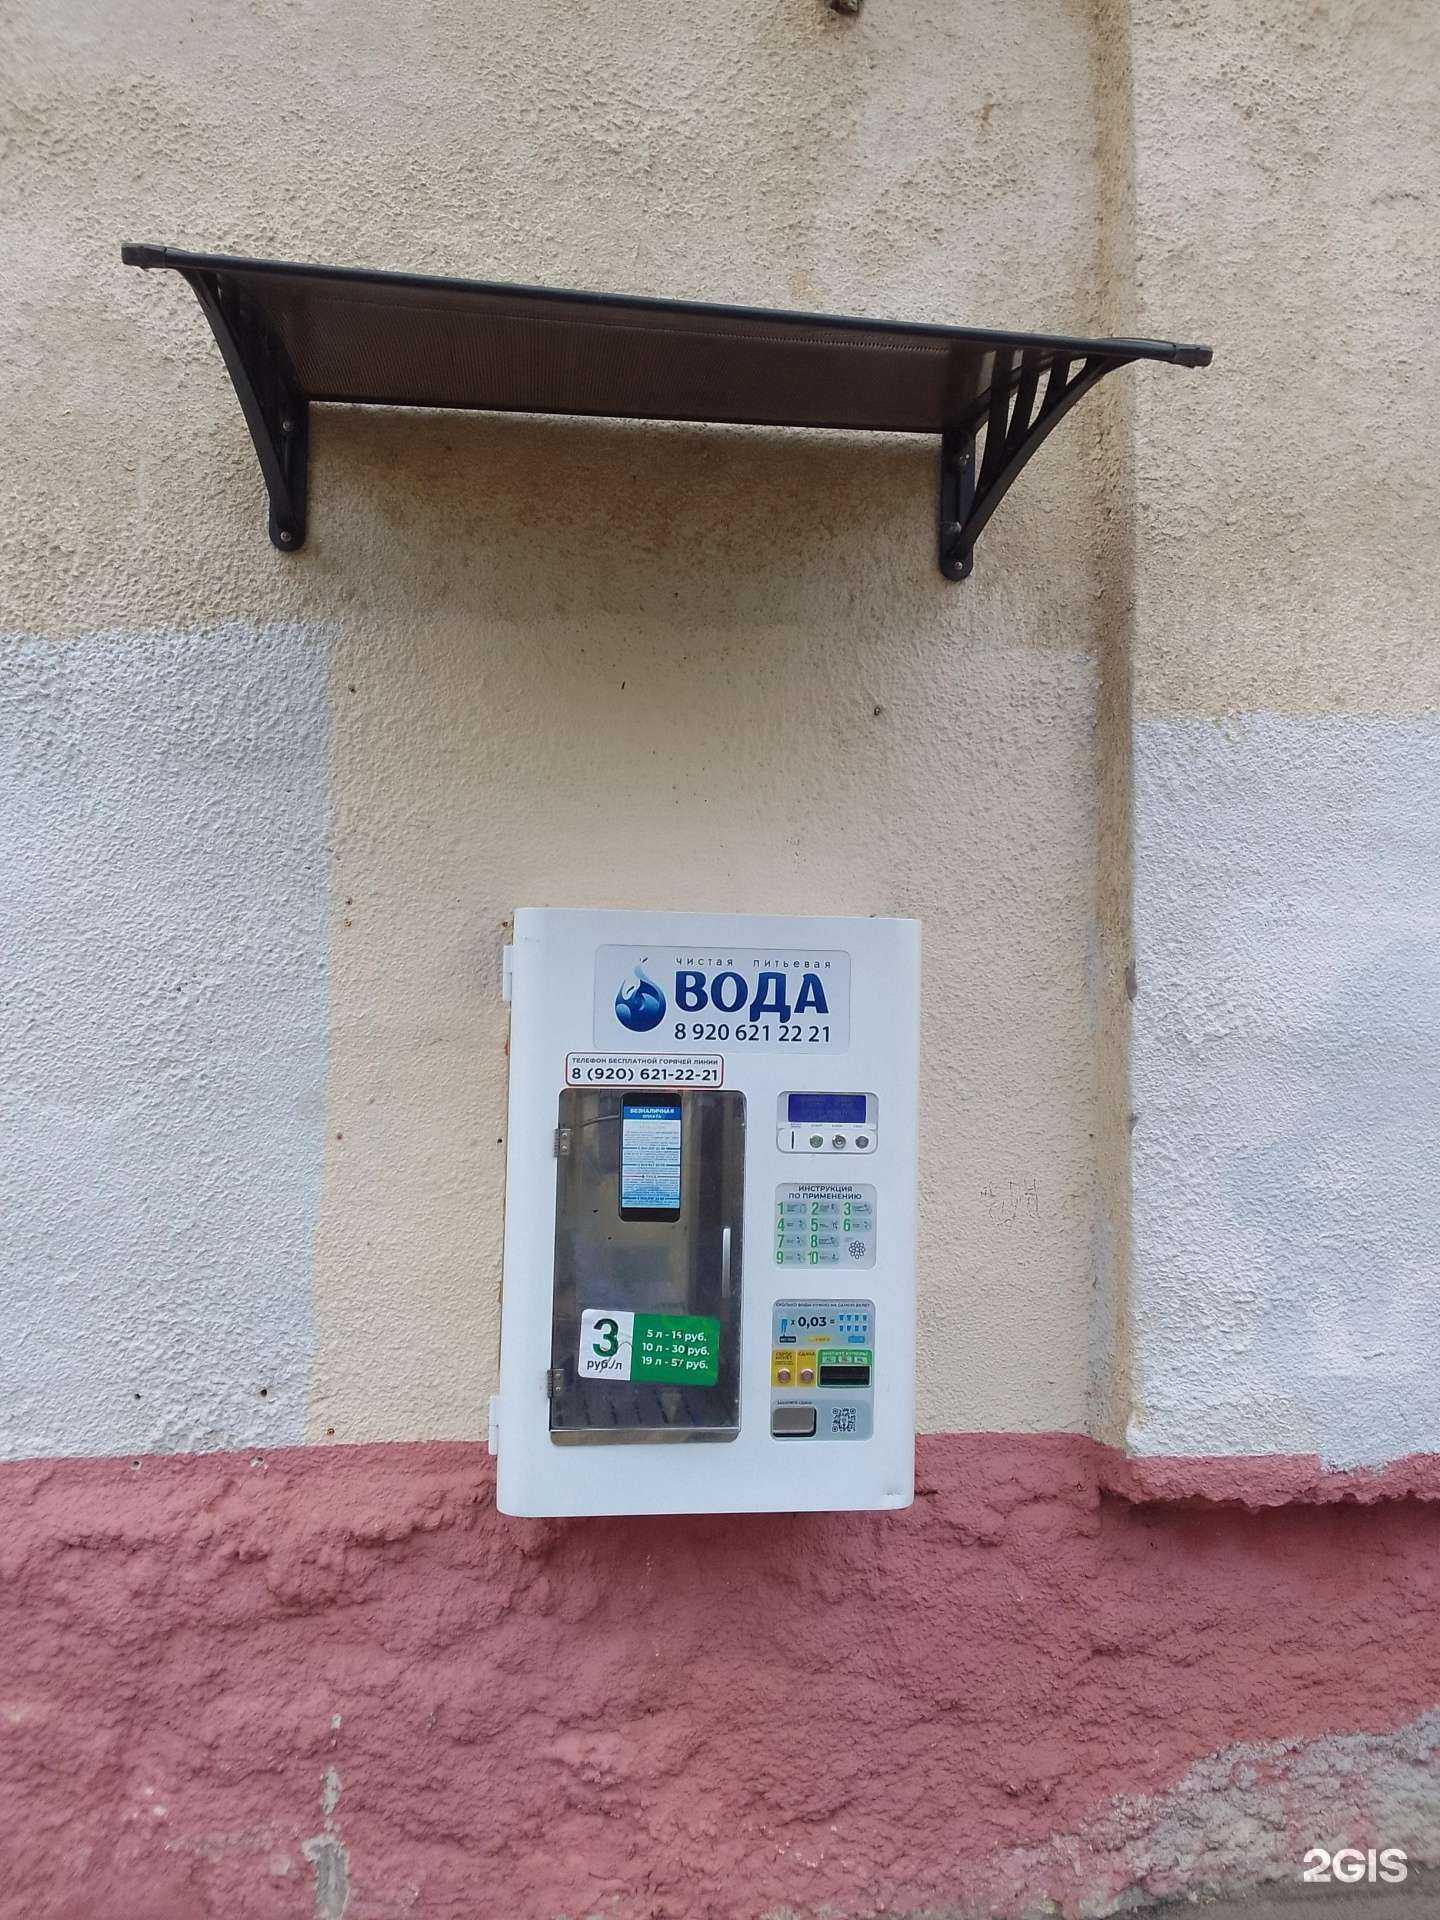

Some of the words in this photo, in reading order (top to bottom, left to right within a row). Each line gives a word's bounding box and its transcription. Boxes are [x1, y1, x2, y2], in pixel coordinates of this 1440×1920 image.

[675, 957, 734, 967] чистая
[753, 958, 832, 969] питьевая
[675, 970, 830, 1024] ВОДА
[674, 1023, 686, 1041] 8
[692, 1024, 730, 1042] 920
[735, 1024, 770, 1042] 621
[778, 1025, 803, 1042] 22
[808, 1025, 831, 1043] 21
[572, 1057, 608, 1065] ТЕЛЕФОН
[608, 1057, 658, 1065] БЕСПЛАТНОЙ
[659, 1058, 692, 1066] ГОРЯЧЕЙ
[571, 1068, 582, 1079] 8
[587, 1068, 634, 1081] (920)
[640, 1068, 718, 1081] 621-22-21
[777, 1201, 784, 1215] 1
[811, 1201, 819, 1215] 2
[843, 1201, 851, 1215] 3
[777, 1218, 785, 1232] 4
[810, 1218, 818, 1232] 5
[843, 1218, 851, 1232] 6
[777, 1234, 785, 1248] 7
[810, 1234, 818, 1248] 8
[776, 1251, 784, 1265] 9
[798, 1316, 827, 1329] 0,03
[592, 1318, 619, 1357] 3
[646, 1329, 654, 1338] 5
[684, 1332, 707, 1343] руб.
[642, 1342, 653, 1351] 10
[672, 1344, 685, 1353] 30
[687, 1346, 710, 1357] руб.
[641, 1356, 653, 1365] 19
[654, 1358, 662, 1366] л
[686, 1360, 708, 1370] руб.
